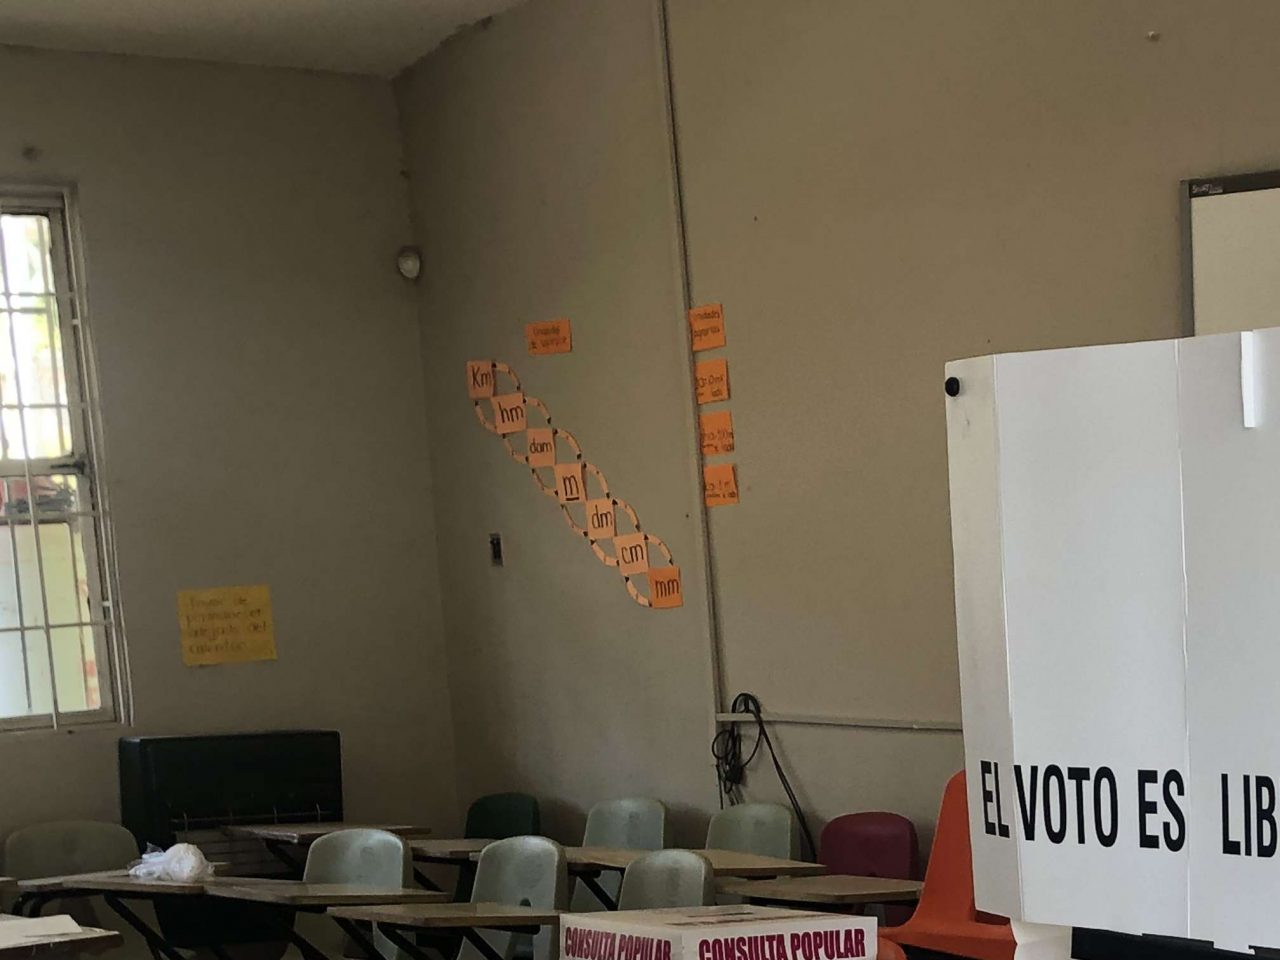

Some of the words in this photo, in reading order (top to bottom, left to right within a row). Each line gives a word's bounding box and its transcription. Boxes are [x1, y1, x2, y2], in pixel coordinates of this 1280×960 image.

[471, 365, 491, 389] Km
[498, 402, 524, 423] hm
[529, 438, 553, 454] dam
[562, 474, 580, 497] m
[592, 504, 613, 529] dm
[621, 543, 644, 565] cm
[655, 578, 680, 599] mm
[980, 759, 1010, 839] EL
[1014, 764, 1118, 848] VOTO
[1138, 768, 1187, 852] ES
